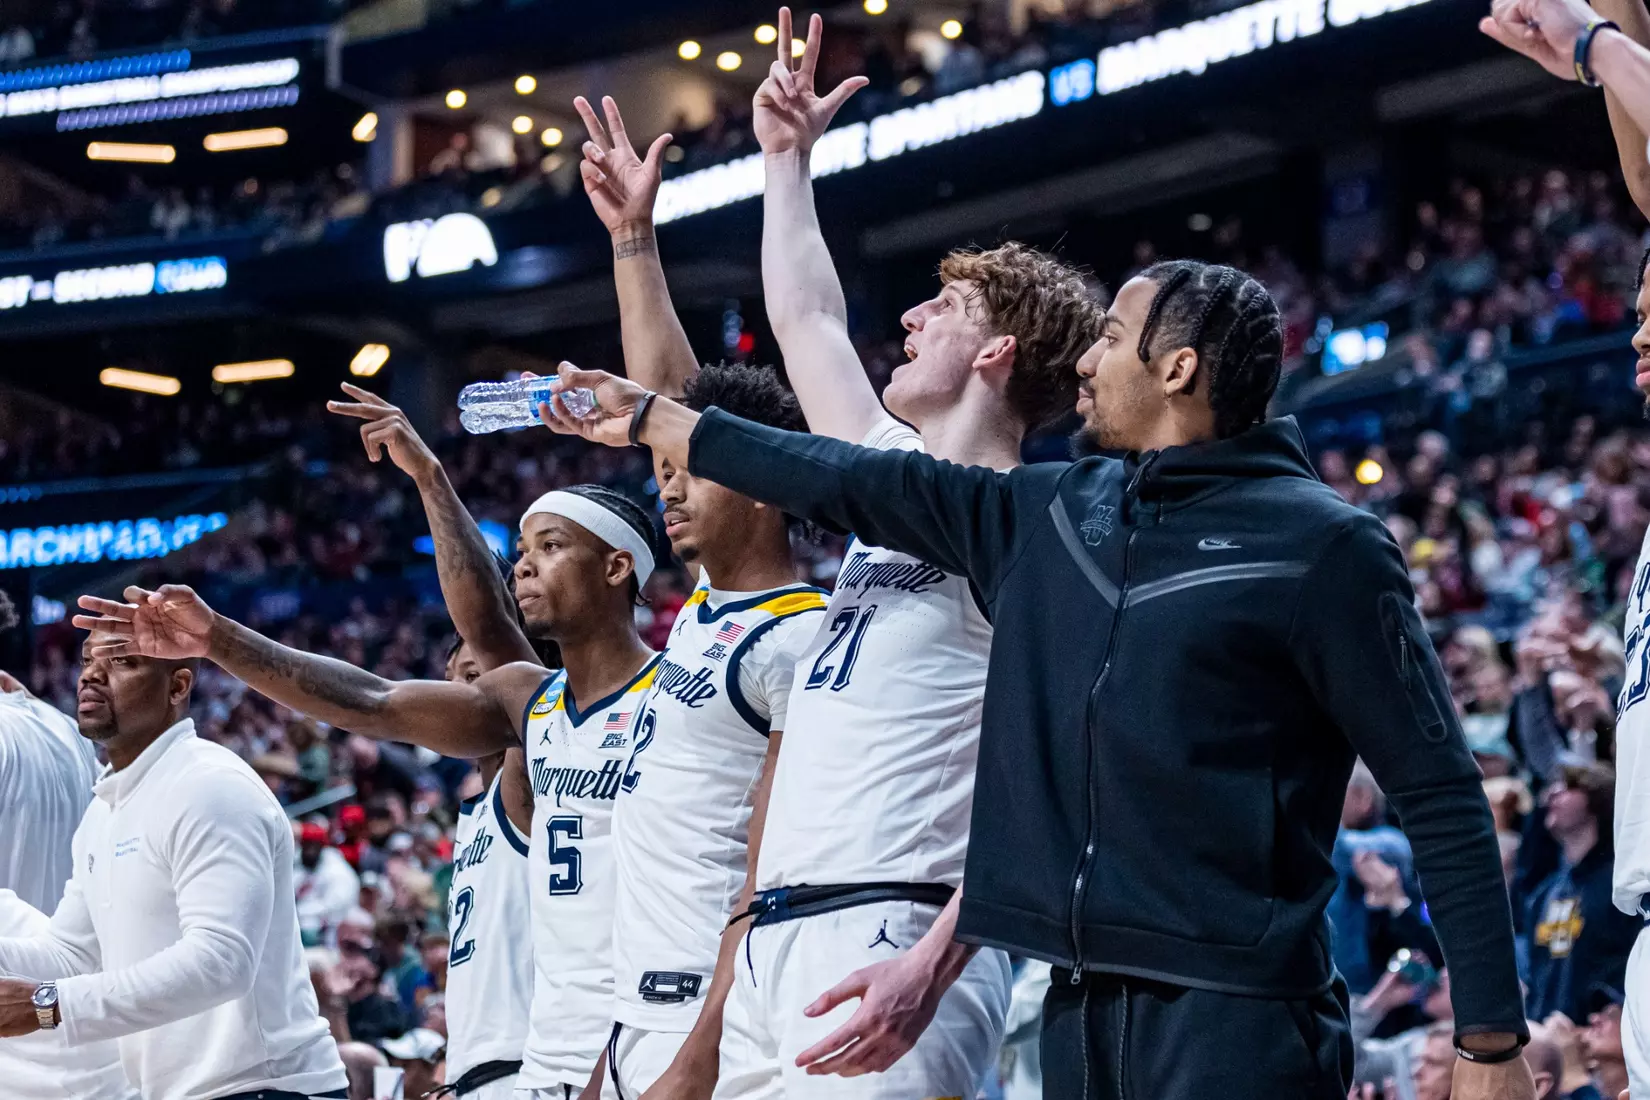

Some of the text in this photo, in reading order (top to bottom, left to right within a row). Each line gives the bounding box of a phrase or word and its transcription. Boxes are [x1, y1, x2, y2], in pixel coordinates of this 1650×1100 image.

[837, 552, 947, 599] Marquette
[705, 648, 727, 659] EAST
[712, 643, 726, 651] BIG
[804, 604, 878, 692] 21
[652, 659, 718, 708] arquette
[601, 739, 628, 747] EAST
[531, 757, 624, 807] Marquett
[547, 815, 584, 896] 5
[682, 980, 693, 989] 44
